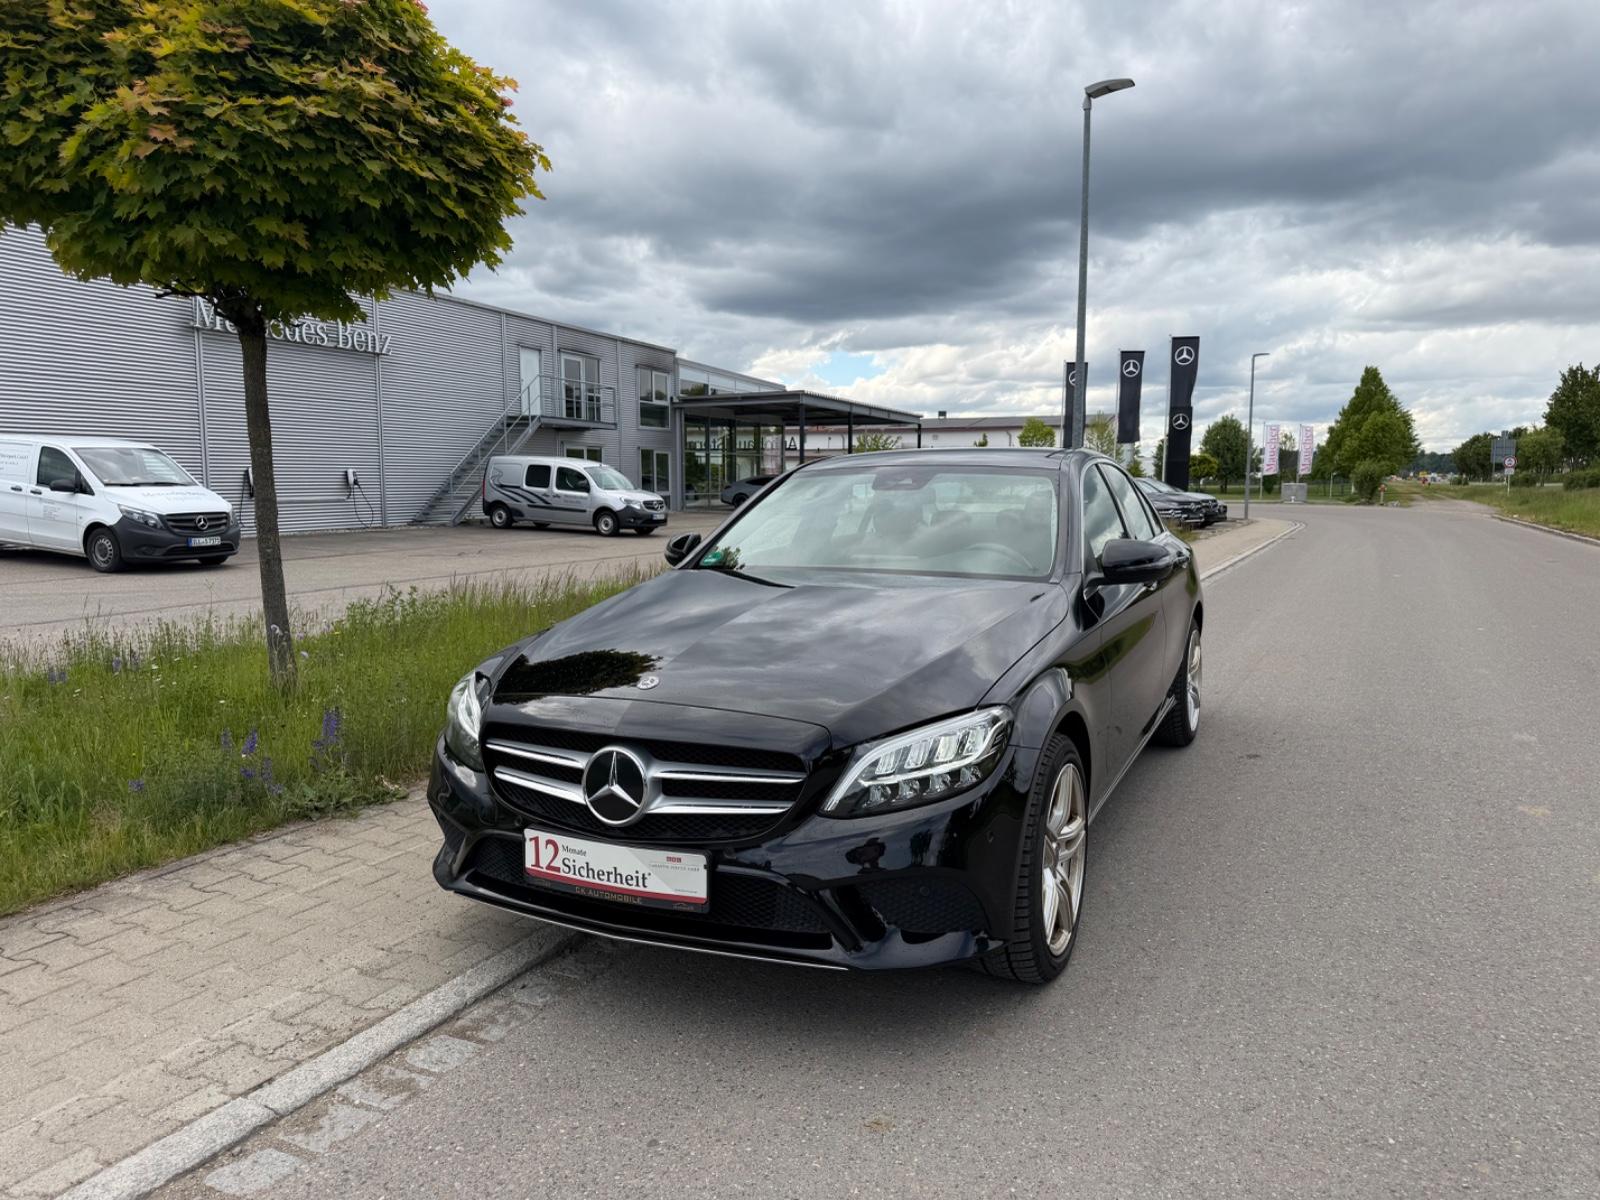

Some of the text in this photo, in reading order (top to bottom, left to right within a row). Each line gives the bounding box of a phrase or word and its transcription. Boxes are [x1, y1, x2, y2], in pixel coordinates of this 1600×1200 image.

[337, 318, 392, 355] Benz
[529, 836, 561, 874] 12
[562, 844, 587, 857] Monate
[587, 889, 642, 904] AUTOMOBILE
